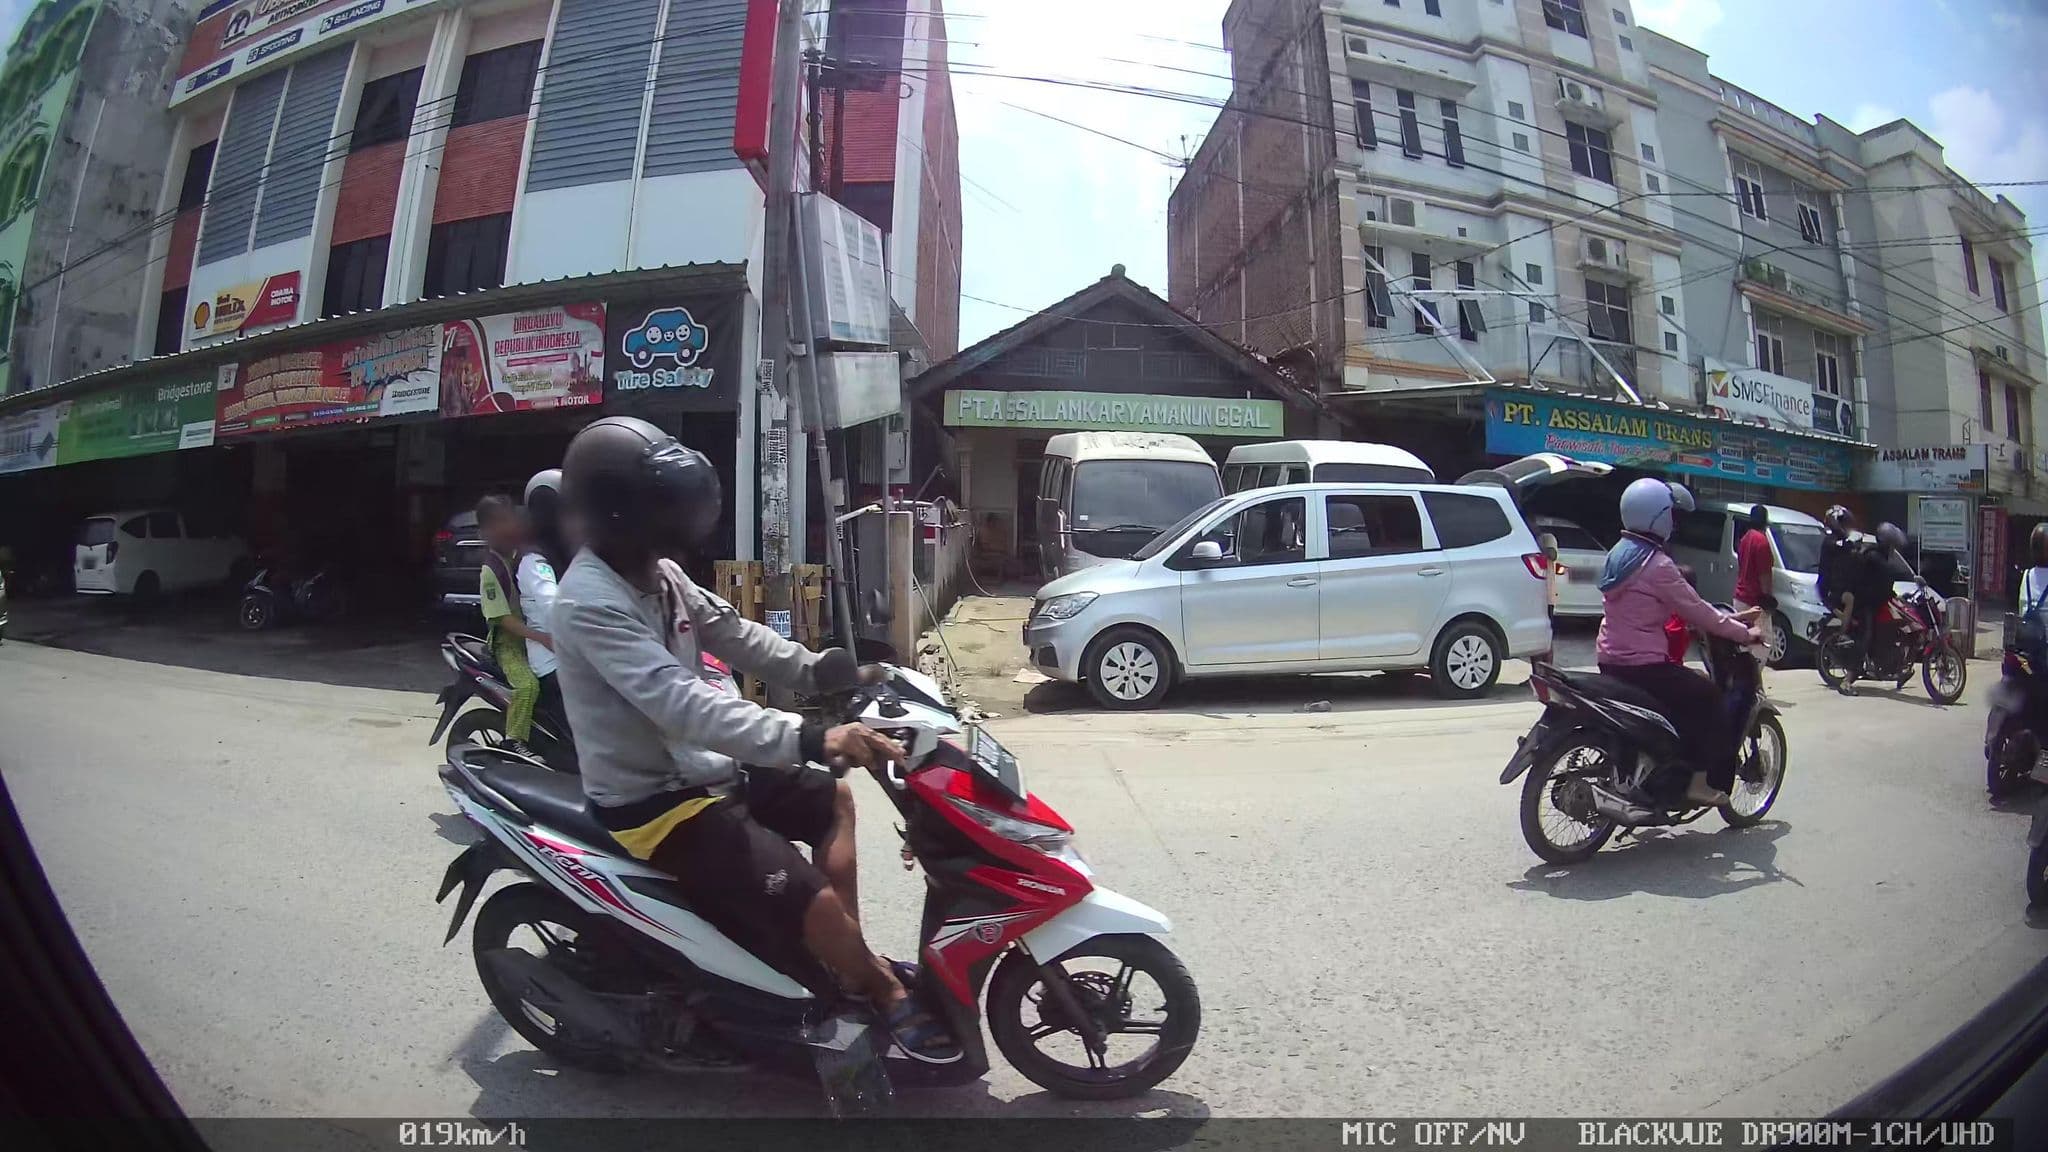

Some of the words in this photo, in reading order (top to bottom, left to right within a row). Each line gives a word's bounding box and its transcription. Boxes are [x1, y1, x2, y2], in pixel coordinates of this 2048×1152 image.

[534, 330, 582, 353] INDONESIA
[158, 380, 213, 402] Bridgestone
[1503, 401, 1541, 427] PT.
[1548, 407, 1649, 438] ASSALAM
[1654, 421, 1713, 449] TRANS
[1016, 878, 1067, 897] HONDA
